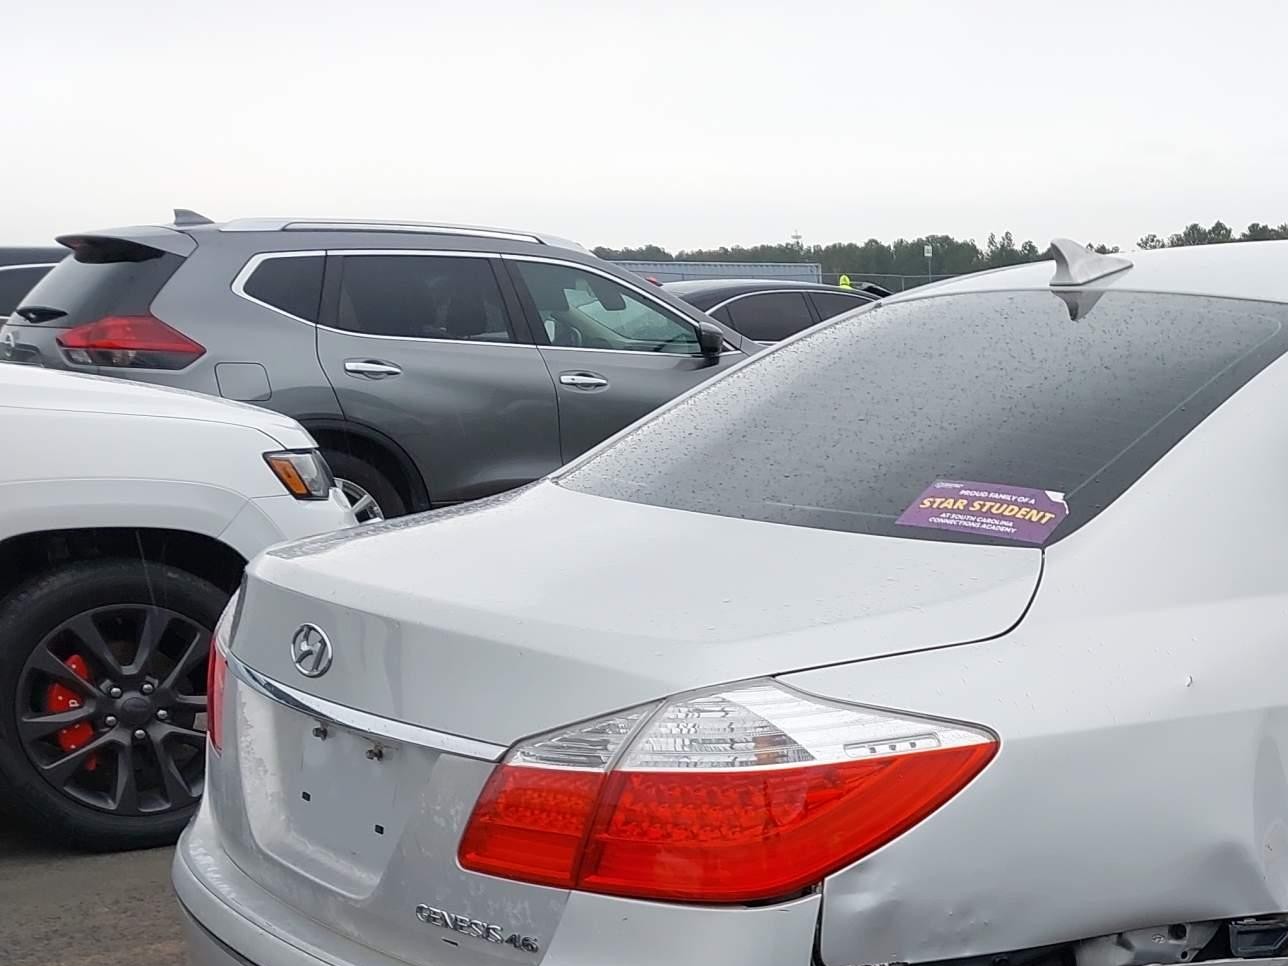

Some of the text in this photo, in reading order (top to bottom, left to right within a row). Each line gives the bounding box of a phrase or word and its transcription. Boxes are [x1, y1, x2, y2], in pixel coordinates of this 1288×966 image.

[959, 489, 989, 498] PROUD
[989, 492, 1018, 502] FAMILY
[920, 498, 1056, 526] STAR STUDENT
[951, 513, 977, 521] SOUTH
[977, 516, 1014, 526] CAROLINA
[928, 517, 1017, 533] CONNECTIONS ACADEMY
[416, 903, 504, 943] GENESIS
